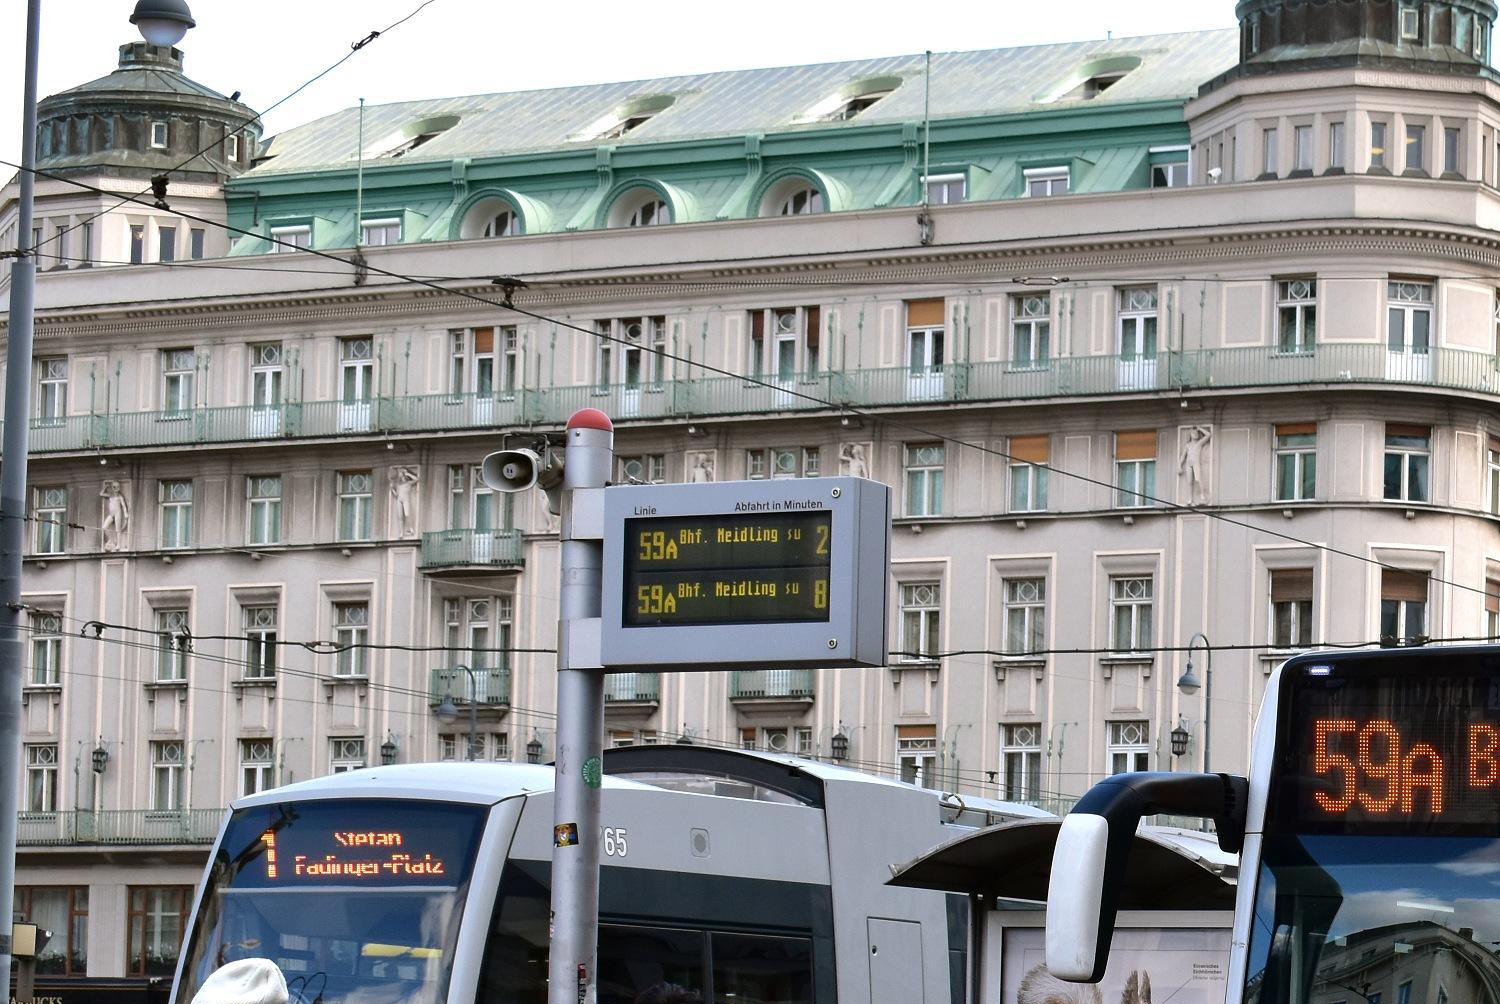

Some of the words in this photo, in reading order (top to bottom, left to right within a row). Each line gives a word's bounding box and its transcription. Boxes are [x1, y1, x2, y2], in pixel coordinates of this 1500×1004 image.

[634, 506, 657, 516] Linie
[735, 501, 770, 512] Abfahrt
[772, 501, 781, 511] in
[783, 500, 823, 511] Minuten
[639, 531, 678, 560] 59A
[680, 529, 708, 545] Bhf.
[717, 526, 778, 543] Meidling
[816, 525, 828, 554] 2
[638, 585, 676, 614] 59A
[678, 582, 706, 598] Bhf.
[716, 581, 776, 597] Meidling
[814, 579, 827, 609] 8
[1314, 719, 1445, 814] 59A
[260, 829, 278, 879] 1
